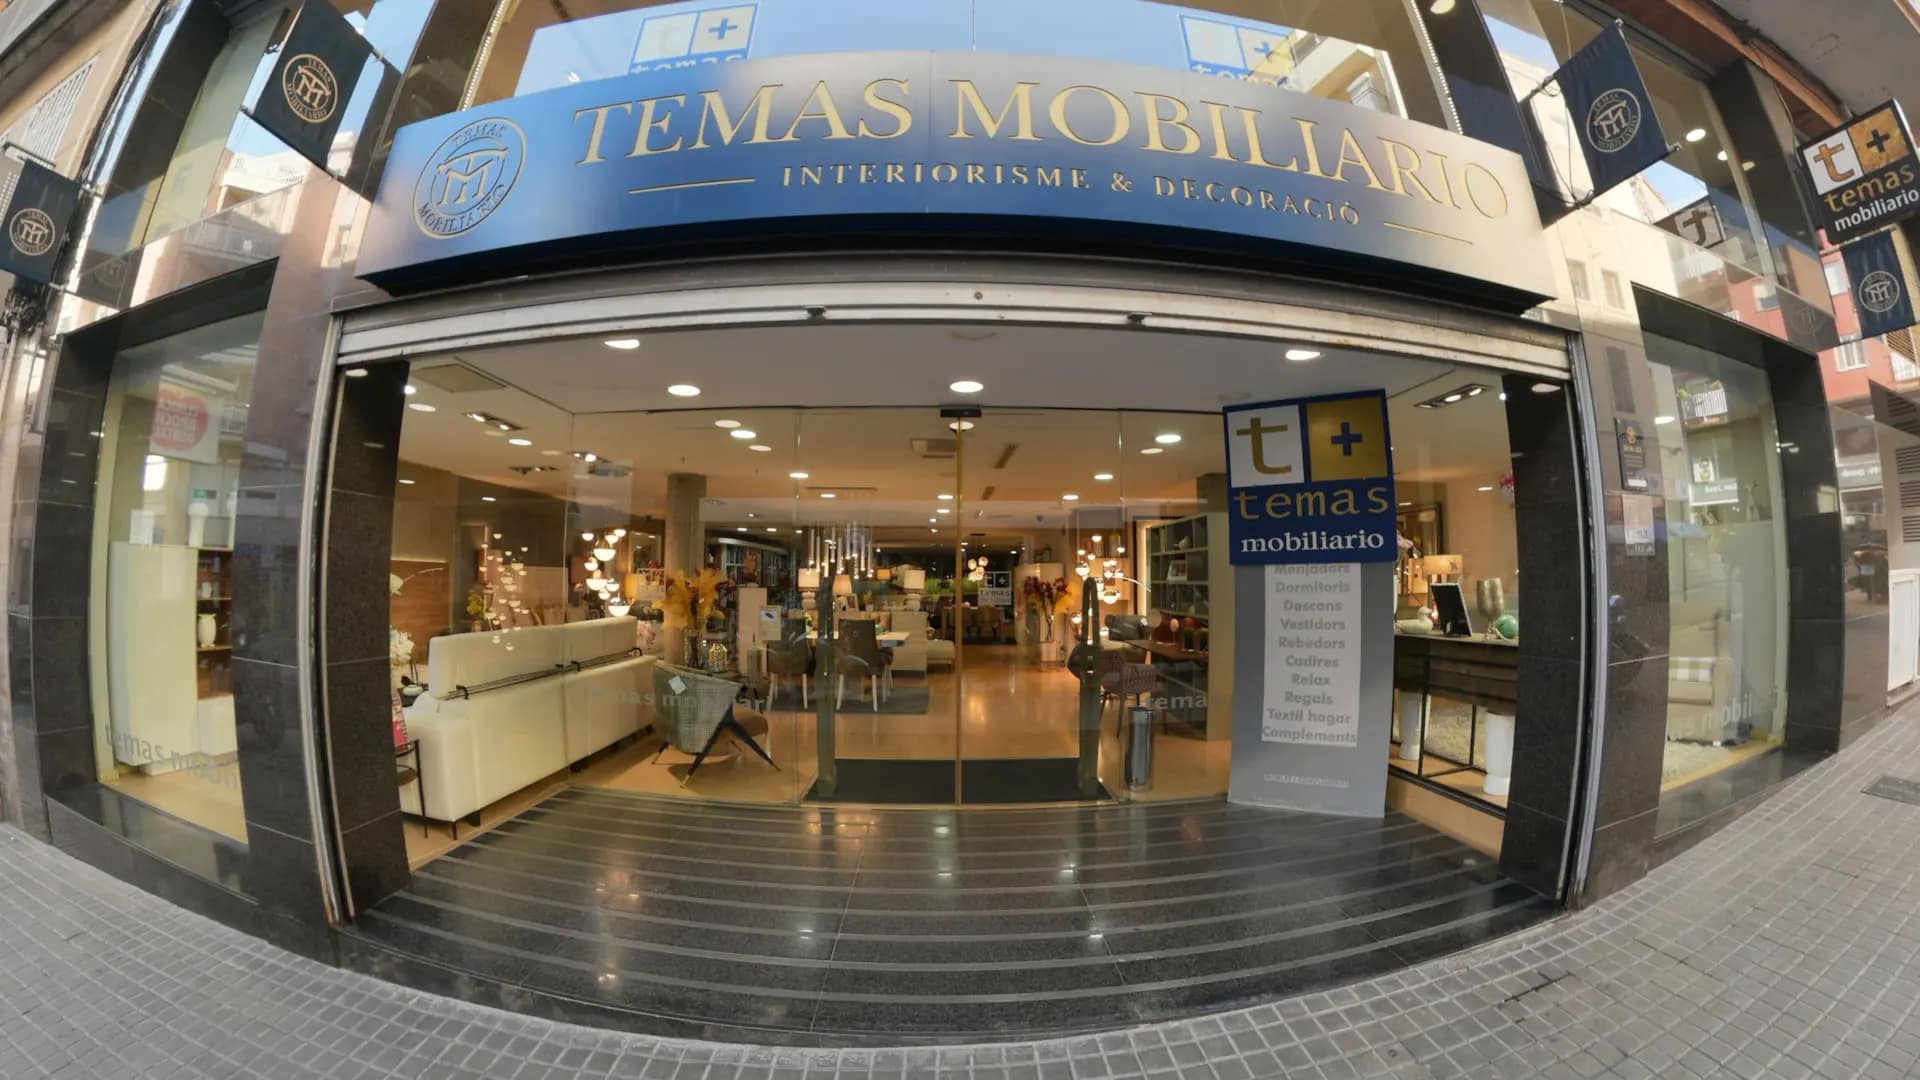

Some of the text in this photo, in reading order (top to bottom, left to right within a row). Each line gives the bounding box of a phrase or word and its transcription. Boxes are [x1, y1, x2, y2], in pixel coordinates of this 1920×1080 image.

[450, 121, 508, 147] TEMAS
[572, 78, 1509, 220] TEMAS MOBILIARIO
[782, 162, 1362, 226] INTERIORISME & DECORACIÓ
[1824, 163, 1915, 213] temas
[1834, 188, 1920, 232] mobiliario
[1232, 486, 1390, 520] temas
[1240, 529, 1385, 553] mobiliario
[1274, 564, 1351, 577] Menjadors
[1274, 580, 1352, 593] Dormitoris
[1283, 599, 1343, 612] Descans
[1279, 617, 1346, 631] Vestidors
[1278, 635, 1346, 649] Rebedors
[1285, 654, 1340, 668] Cadires
[1290, 672, 1331, 686] Relax
[1266, 707, 1352, 727] Textil hogar
[1261, 725, 1357, 743] Complements
